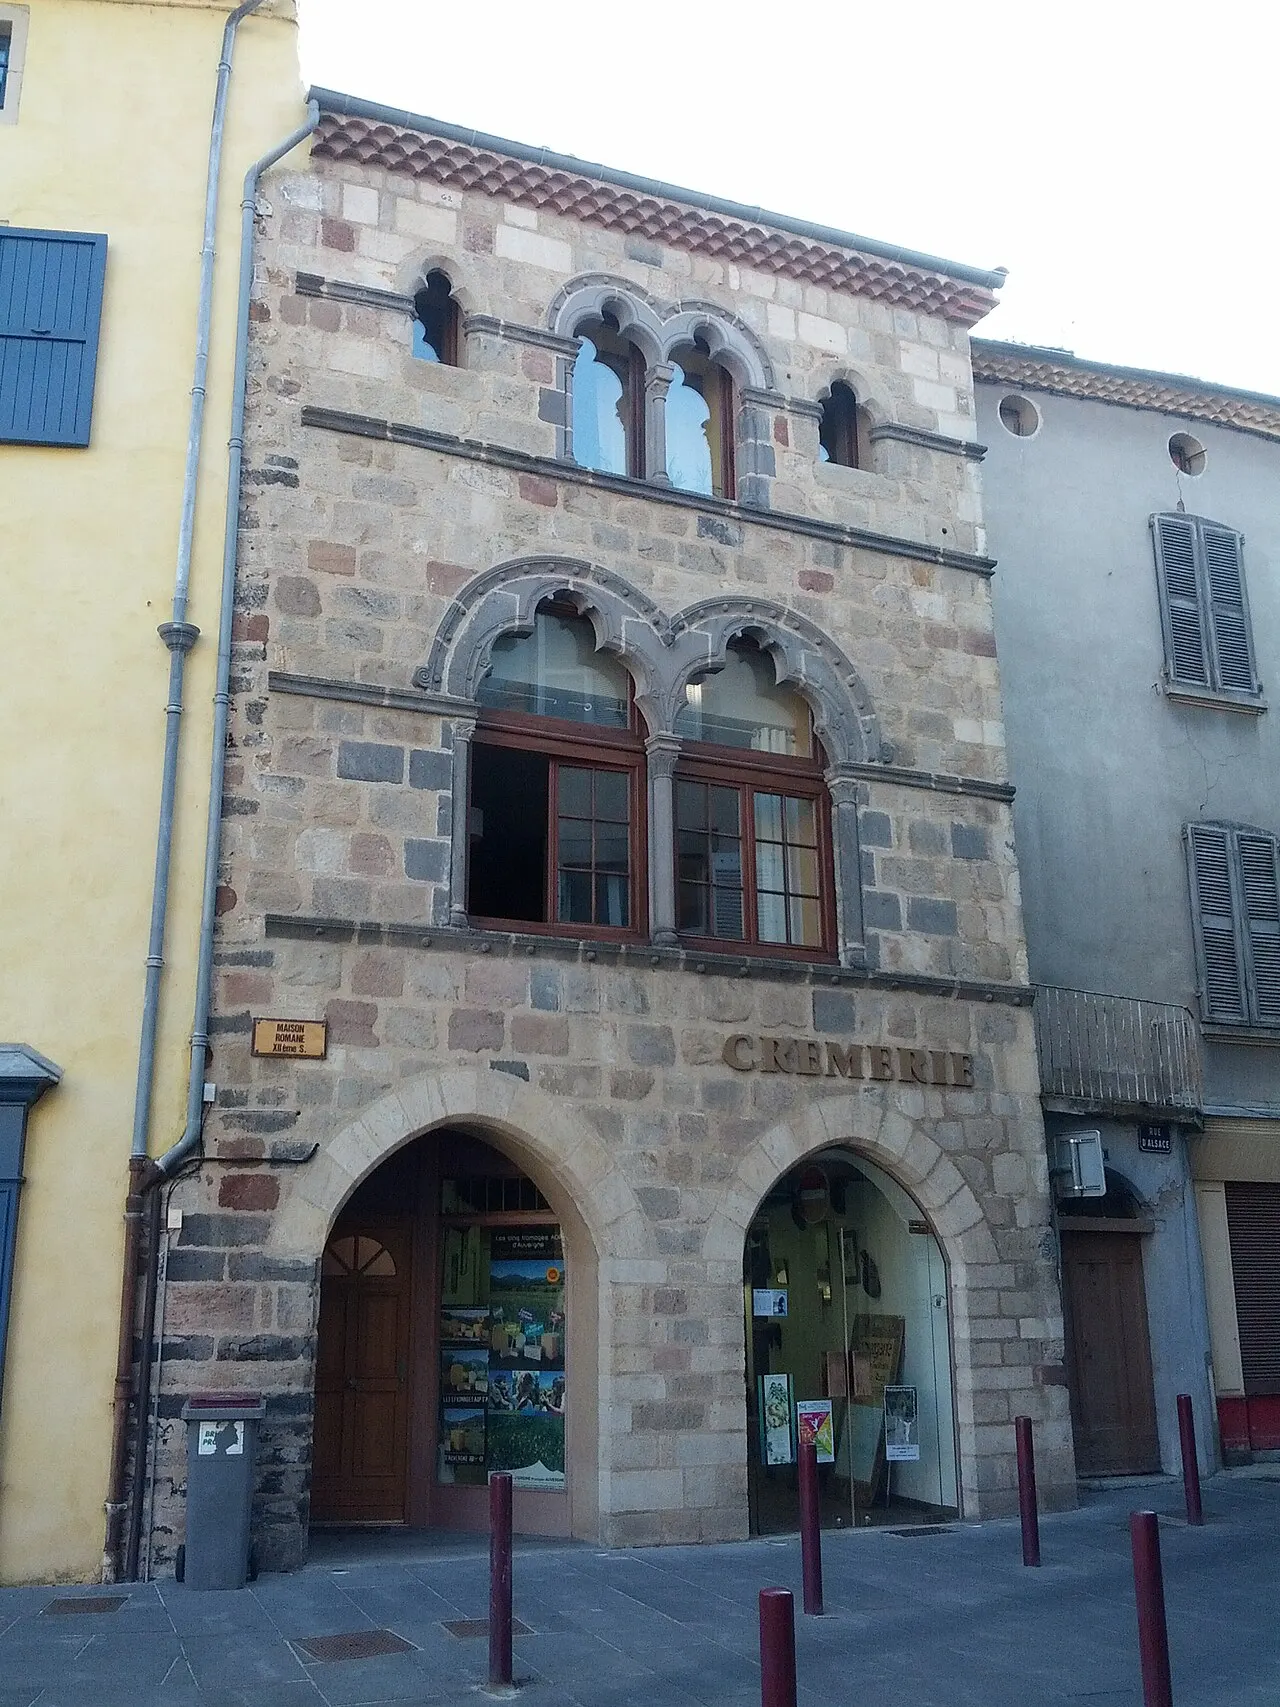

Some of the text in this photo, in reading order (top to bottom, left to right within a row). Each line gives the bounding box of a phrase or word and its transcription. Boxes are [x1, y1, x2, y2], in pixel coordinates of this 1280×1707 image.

[276, 1023, 305, 1033] MAISON
[275, 1033, 306, 1044] ROMANE
[298, 1044, 307, 1053] S.
[721, 1033, 975, 1088] CREMERIE
[1149, 1127, 1161, 1136] RUE
[1142, 1138, 1170, 1149] D'ALSACE
